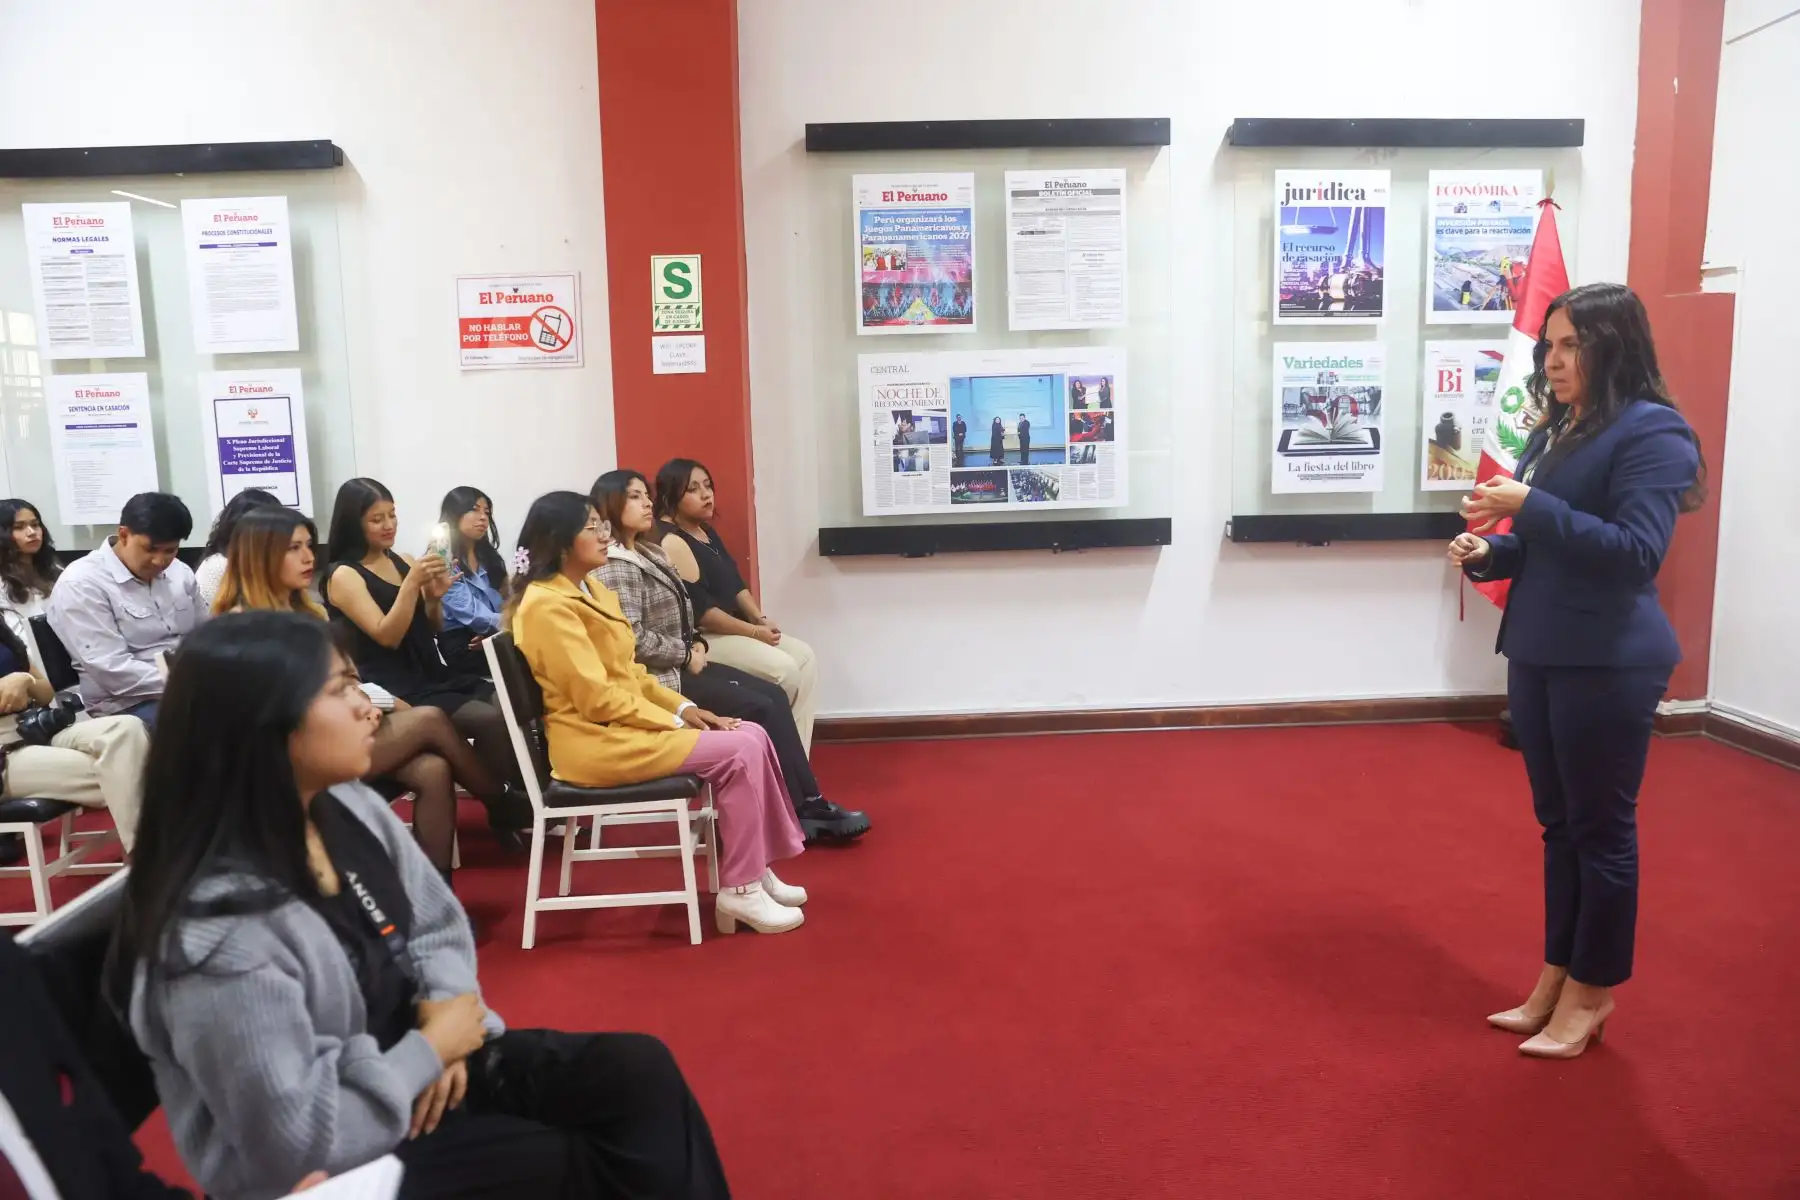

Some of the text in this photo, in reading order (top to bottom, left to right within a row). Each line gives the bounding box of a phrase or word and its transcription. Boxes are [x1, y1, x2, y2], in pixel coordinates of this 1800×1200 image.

[882, 190, 948, 202] El Peruano
[52, 216, 104, 226] El Peruano
[874, 216, 894, 224] Perú
[896, 215, 943, 224] organizará
[864, 225, 893, 234] Juegos
[894, 224, 960, 232] Panamericanos
[862, 232, 969, 242] Parapanamericanos 2027
[1283, 242, 1293, 252] El
[1282, 252, 1295, 262] de
[663, 262, 692, 299] S
[479, 292, 554, 304] El Peruano
[484, 323, 521, 331] HABLAR
[484, 332, 528, 342] TELÉFONO
[1283, 356, 1364, 369] Variedades
[870, 365, 910, 374] CENTRAL
[1438, 368, 1462, 392] Bi
[75, 390, 120, 398] El Peruano
[877, 388, 943, 399] NOCHE DE
[105, 404, 130, 412] CASACIÓN
[874, 400, 945, 408] RECONOCIMIENTO
[1288, 460, 1374, 472] La fiesta del libro
[345, 871, 386, 923] SONY
